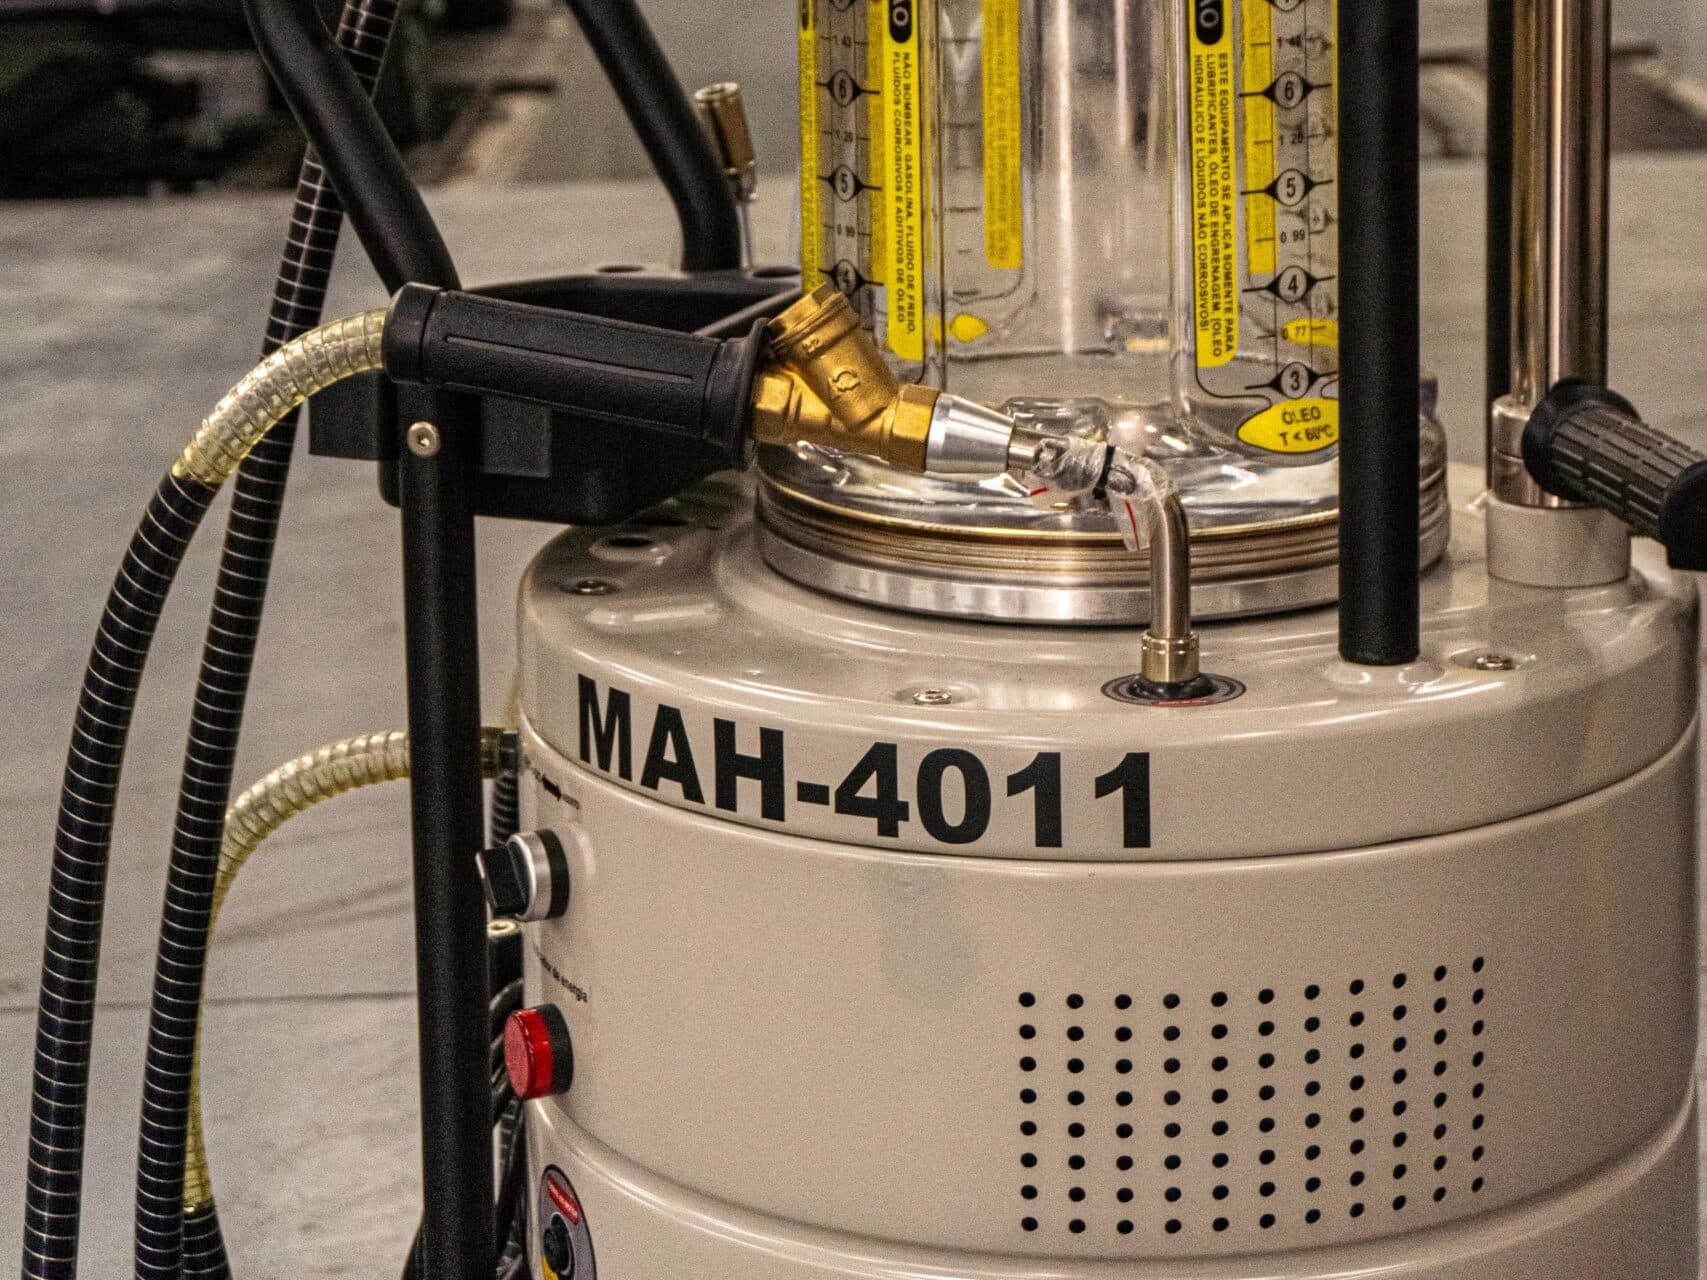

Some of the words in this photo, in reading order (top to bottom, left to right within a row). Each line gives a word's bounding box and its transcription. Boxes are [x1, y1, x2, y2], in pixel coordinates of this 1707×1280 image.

[1218, 52, 1229, 87] ESTE
[839, 79, 847, 99] 6
[1284, 80, 1294, 101] 6
[1219, 88, 1231, 181] EQUIPAMENTO
[894, 109, 903, 192] CORROSIVOS
[840, 173, 849, 193] 5
[1221, 184, 1231, 200] SE
[1286, 177, 1296, 198] 5
[895, 195, 904, 203] E
[1209, 201, 1219, 217] DE
[896, 206, 905, 264] ADITIVOS
[1222, 204, 1233, 250] APLICA
[896, 268, 905, 282] DE
[906, 274, 915, 291] DE
[1224, 253, 1234, 314] SOMENTE
[1288, 274, 1298, 294] 4
[1225, 318, 1235, 352] PARA
[1290, 371, 1300, 391] 3
[1279, 432, 1288, 446] T
[576, 673, 1152, 849] MAH-4011
